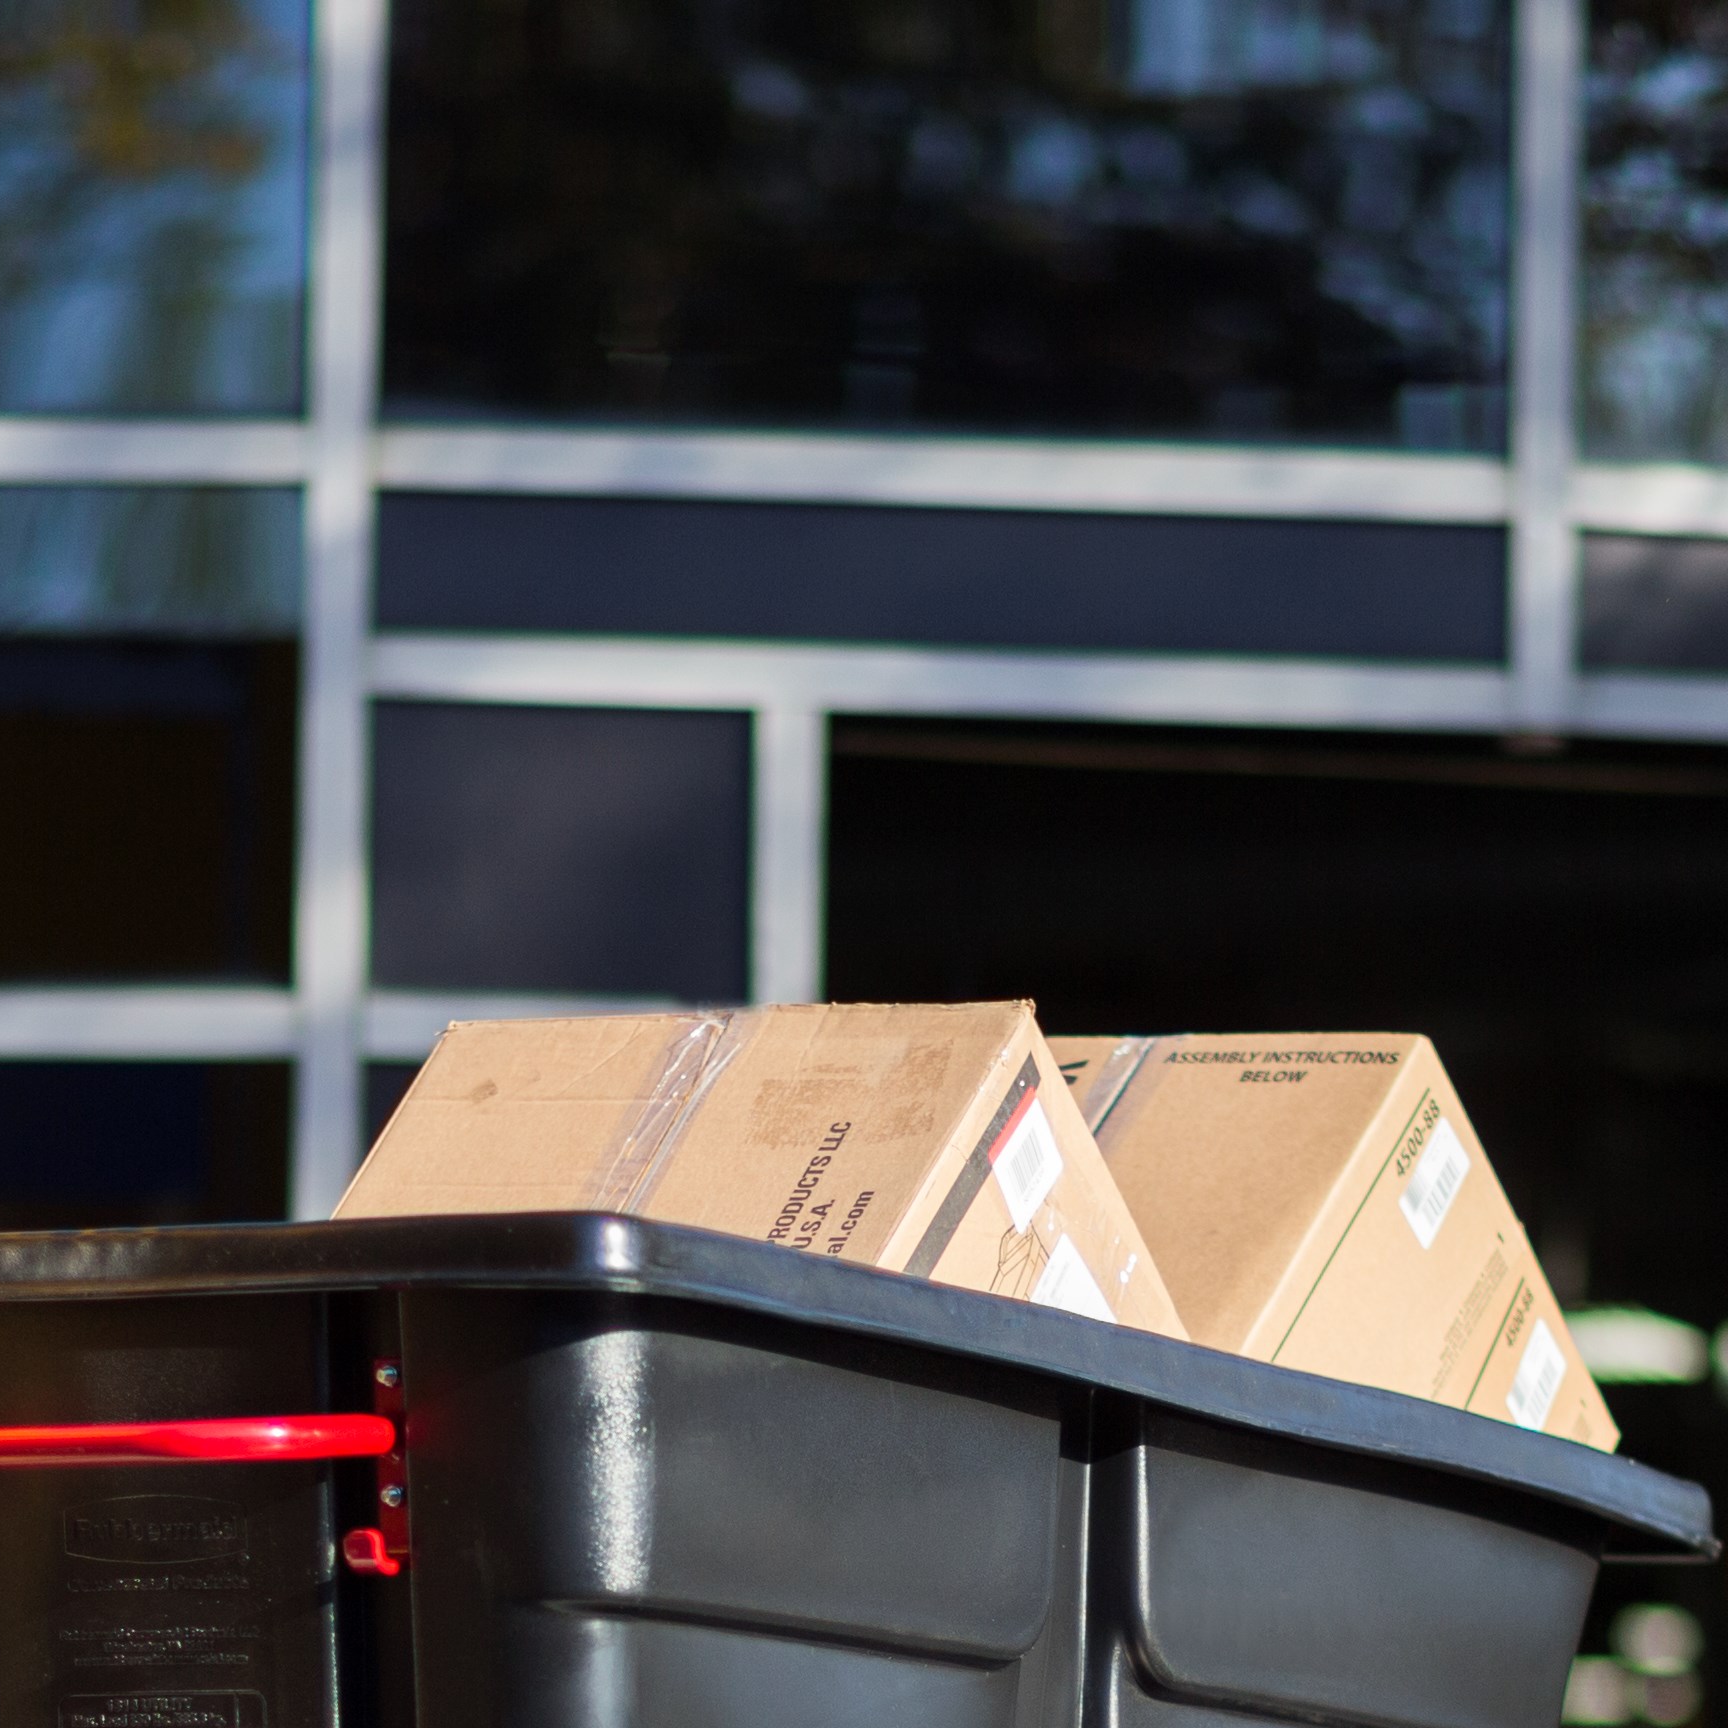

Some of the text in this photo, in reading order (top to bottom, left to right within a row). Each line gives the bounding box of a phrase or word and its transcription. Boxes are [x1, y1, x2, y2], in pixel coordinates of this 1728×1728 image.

[1163, 1050, 1400, 1065] ASSEMBLY INSTRUCTIONS
[1239, 1070, 1308, 1083] BELOW
[1395, 1098, 1441, 1177] 4500-88
[766, 1121, 852, 1244] RODUCTS LLC
[827, 1190, 876, 1257] al.com
